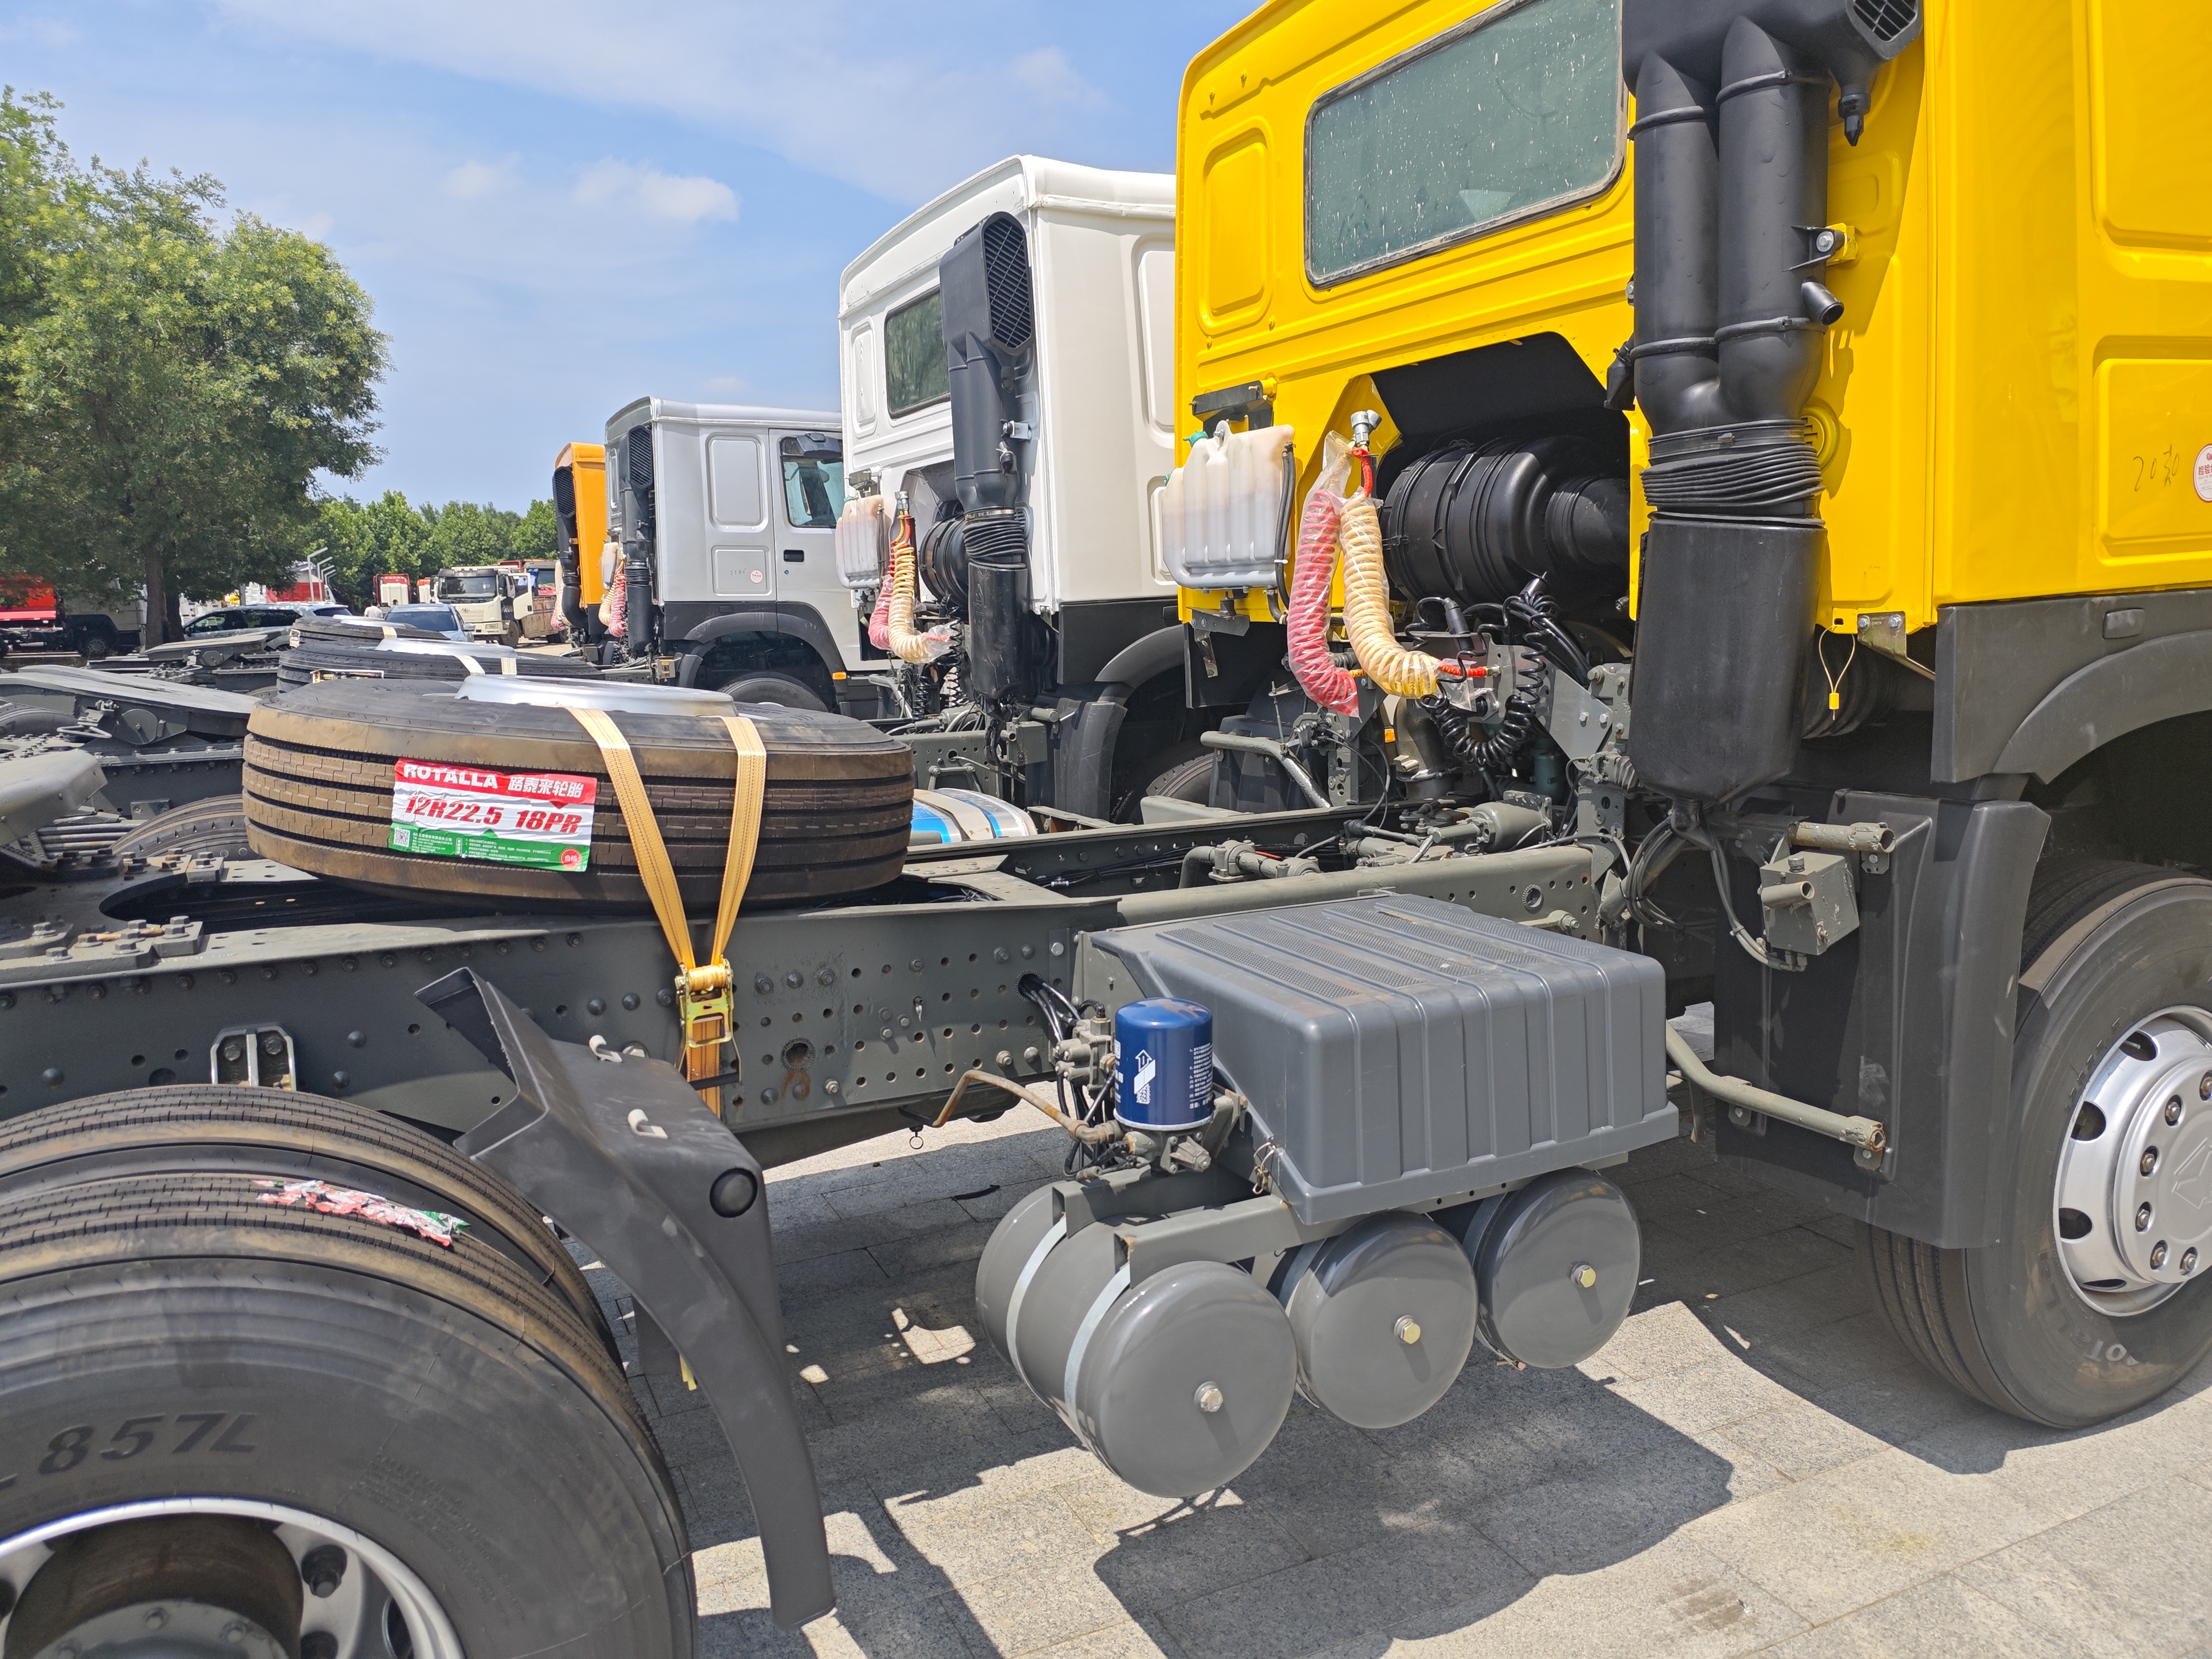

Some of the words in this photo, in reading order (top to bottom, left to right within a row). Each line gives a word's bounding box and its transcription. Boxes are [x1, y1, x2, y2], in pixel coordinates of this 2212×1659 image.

[403, 764, 498, 789] ROTALLA
[405, 795, 504, 825] 12R22.5
[515, 810, 583, 834] 18PR
